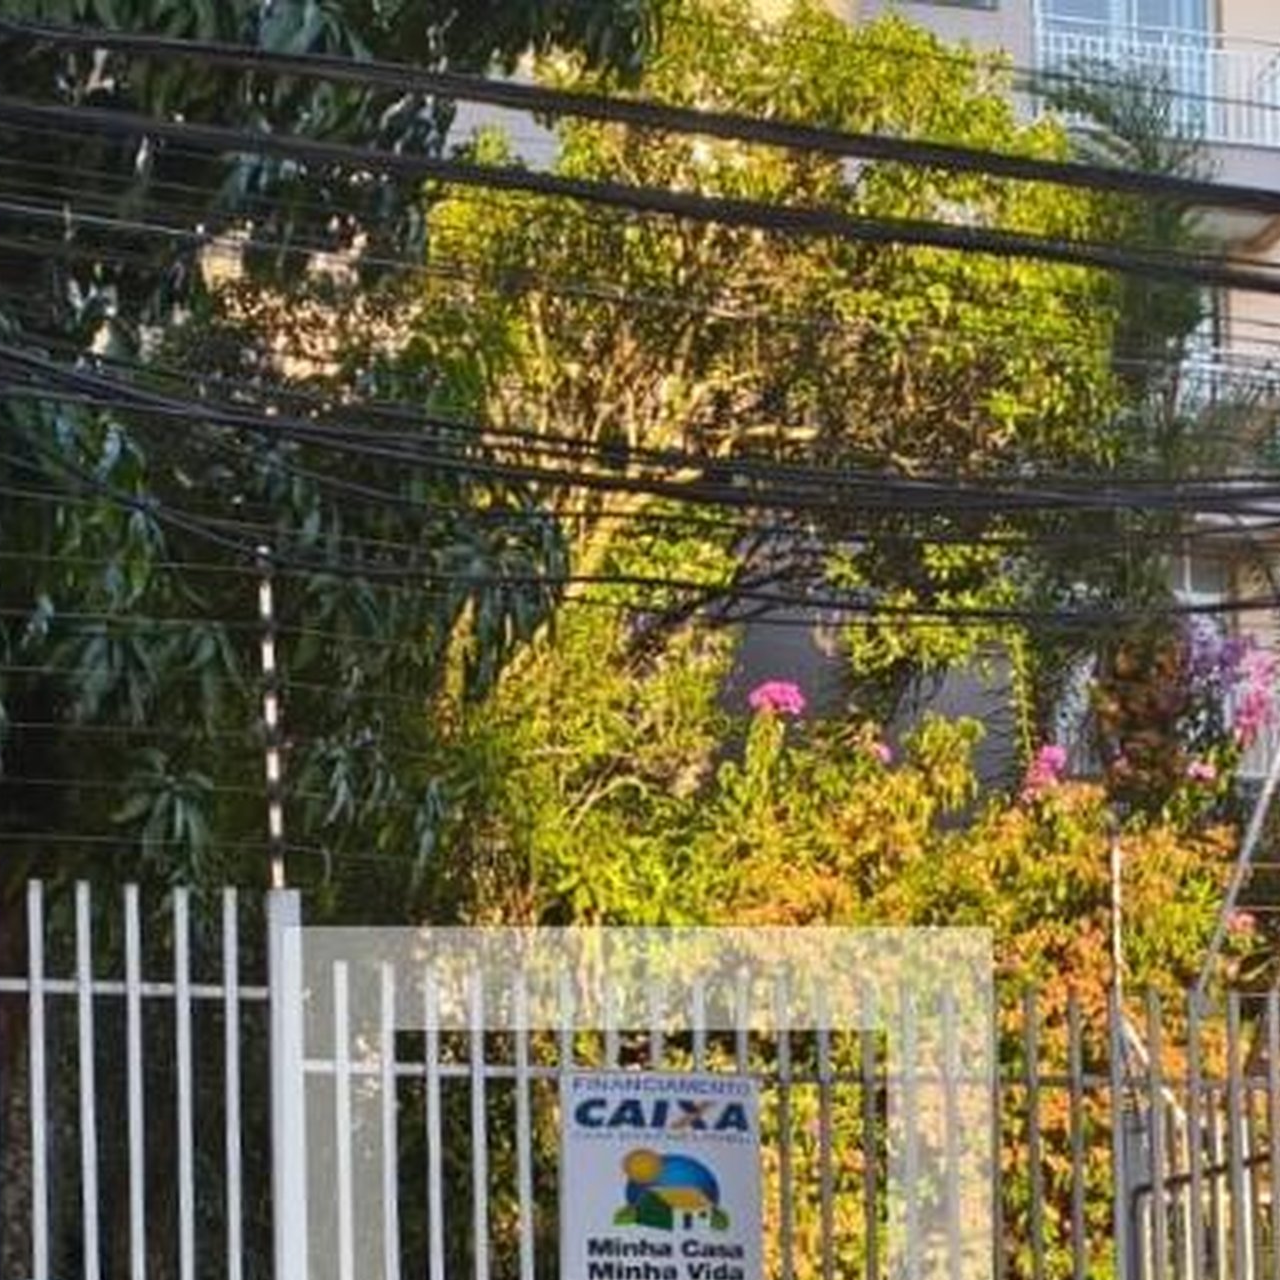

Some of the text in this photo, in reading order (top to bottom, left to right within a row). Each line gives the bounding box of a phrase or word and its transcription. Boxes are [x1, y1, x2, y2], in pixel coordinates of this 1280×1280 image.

[574, 1098, 748, 1131] CAIXA
[587, 1239, 744, 1259] Minha Casa
